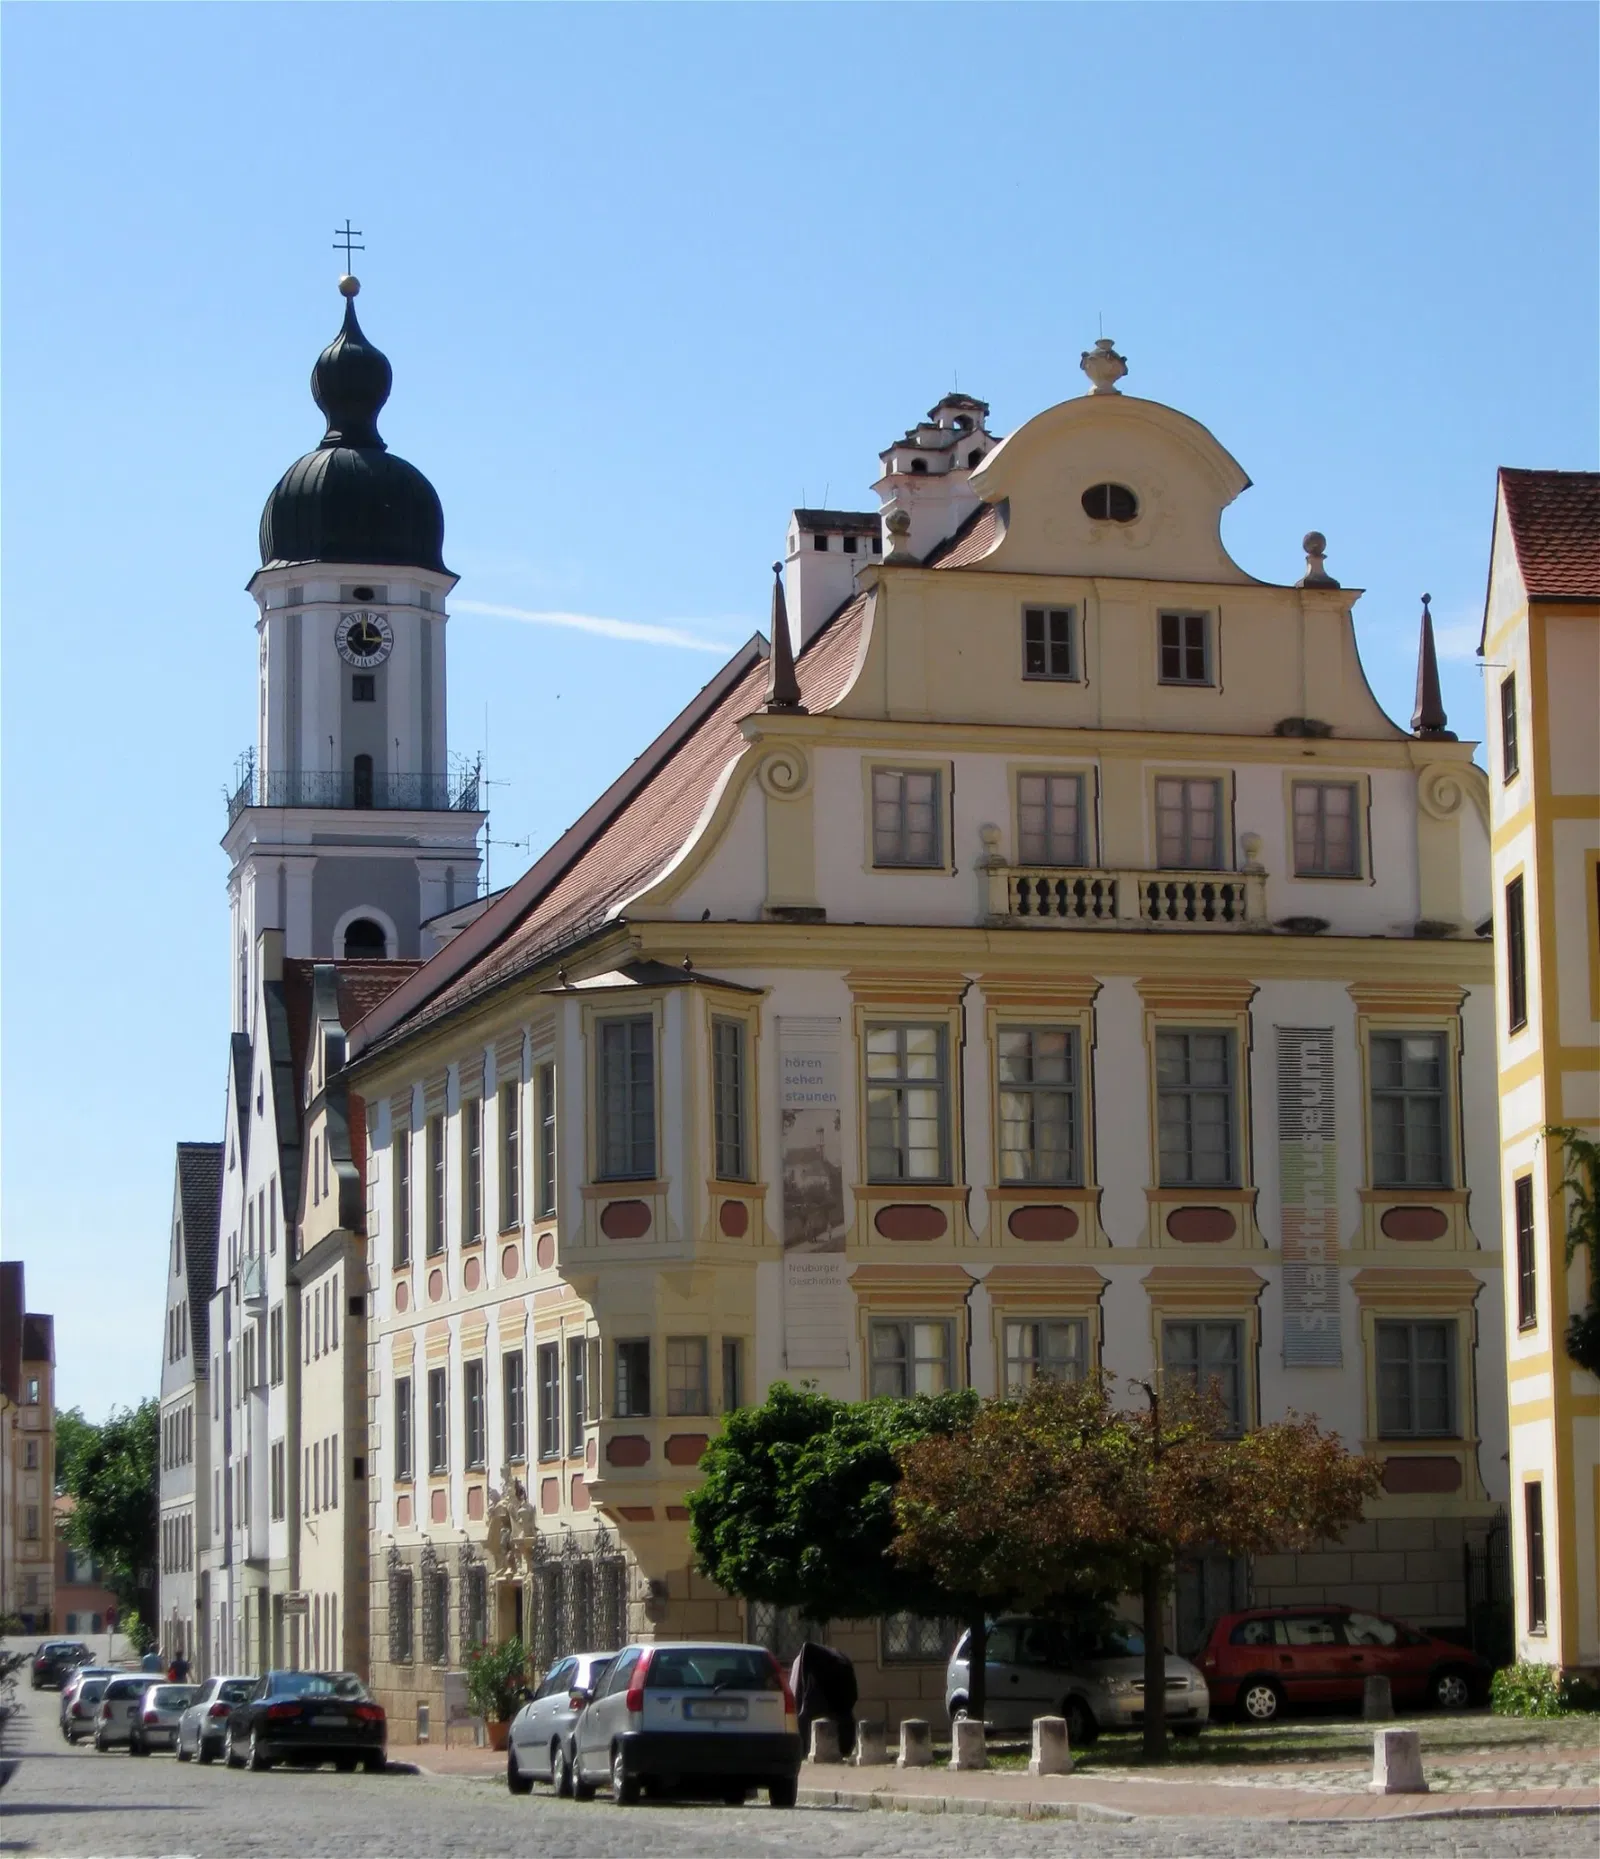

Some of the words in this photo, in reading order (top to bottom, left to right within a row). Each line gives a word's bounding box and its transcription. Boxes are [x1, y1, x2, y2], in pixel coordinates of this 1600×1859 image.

[785, 1057, 822, 1068] hören
[784, 1074, 823, 1085] sehen
[785, 1091, 837, 1102] staunen
[1296, 1041, 1328, 1332] Stadtmuseum
[788, 1276, 842, 1286] Geschichte
